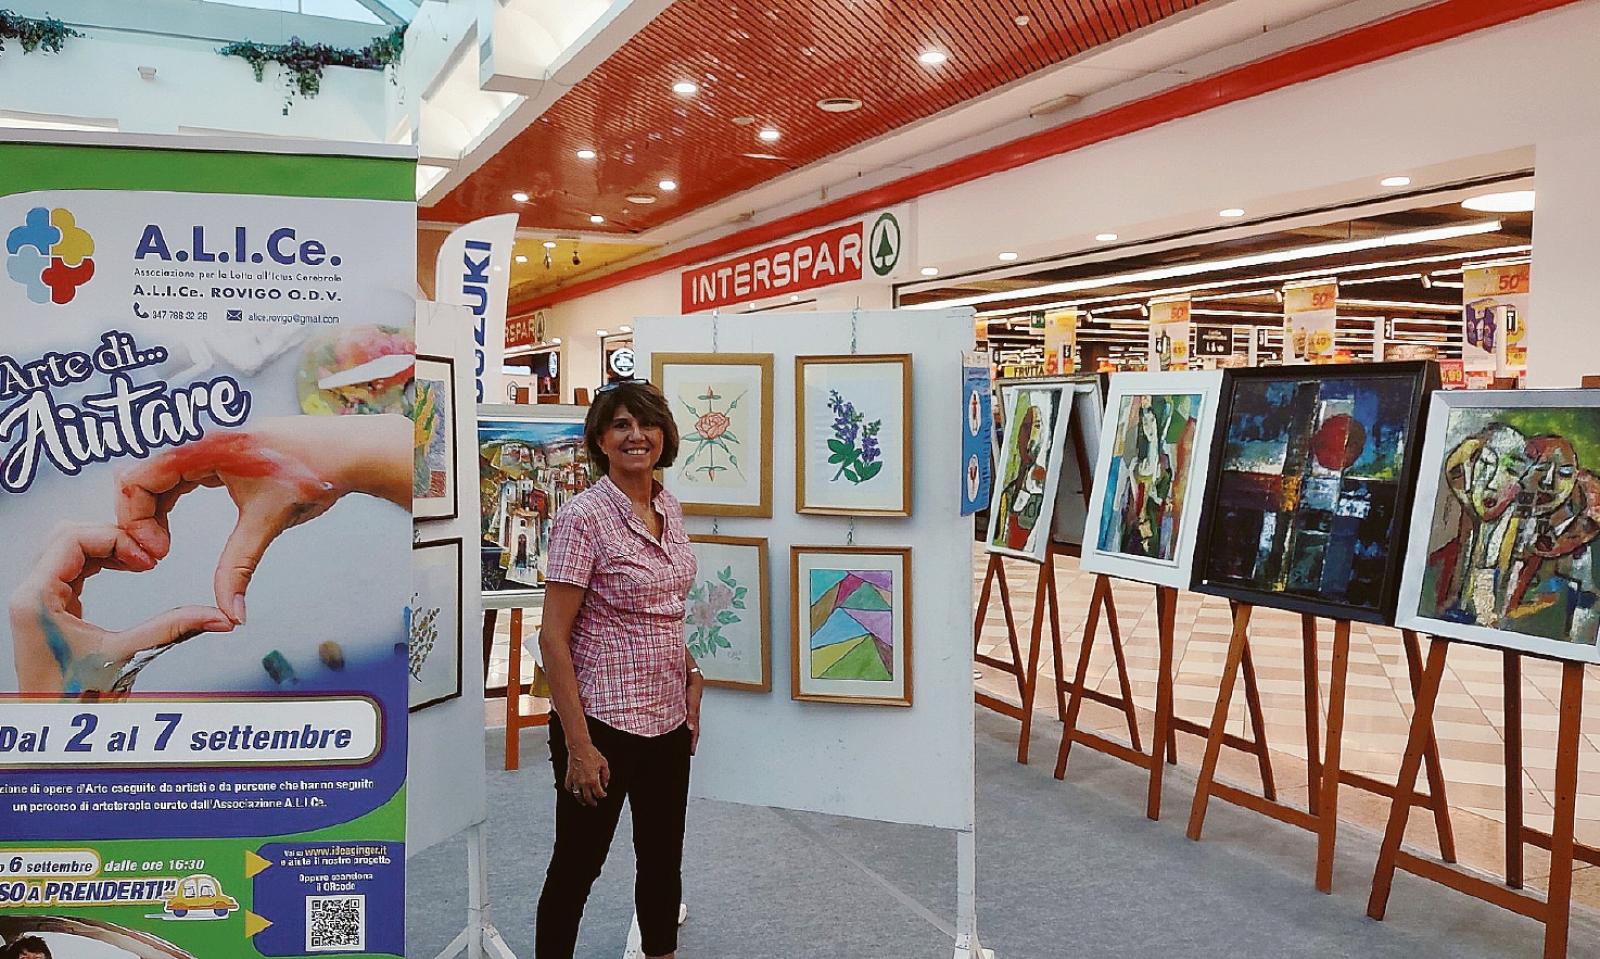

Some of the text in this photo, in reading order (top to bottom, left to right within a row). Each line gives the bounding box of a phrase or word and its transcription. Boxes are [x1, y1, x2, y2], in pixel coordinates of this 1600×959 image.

[134, 224, 343, 266] A.L.I.Ce.
[134, 268, 195, 278] Associazione
[199, 271, 215, 280] per
[219, 270, 227, 279] la
[230, 270, 253, 280] Lotta
[692, 233, 862, 305] INTERSPAR
[133, 284, 342, 302] A.L.I.Ce. ROVIGO O.D.V.
[0, 354, 91, 397] Arte
[1014, 365, 1044, 377] FRUTTA
[0, 376, 249, 490] Aiutare
[0, 712, 352, 753] Dal 2 al 7 settembre
[30, 783, 40, 794] di
[43, 784, 73, 796] opere
[76, 782, 108, 794] d'Arte
[111, 782, 157, 795] eseguite
[160, 782, 173, 793] da
[219, 781, 232, 792] da
[235, 781, 276, 793] persone
[279, 780, 299, 791] che
[300, 779, 334, 791] hanno
[336, 778, 374, 791] seguito
[13, 803, 27, 812] un
[29, 802, 77, 813] percorso
[80, 801, 89, 811] di
[92, 800, 151, 812] arteterapia
[154, 799, 188, 810] curato
[304, 845, 387, 857] www.ideaginger.it
[9, 856, 24, 873] 6
[26, 860, 93, 873] settembre
[104, 859, 137, 872] dalle
[142, 861, 163, 871] ore
[169, 859, 205, 871] 16:30
[322, 856, 351, 865] nostro
[0, 882, 26, 901] SO
[27, 887, 39, 901] A
